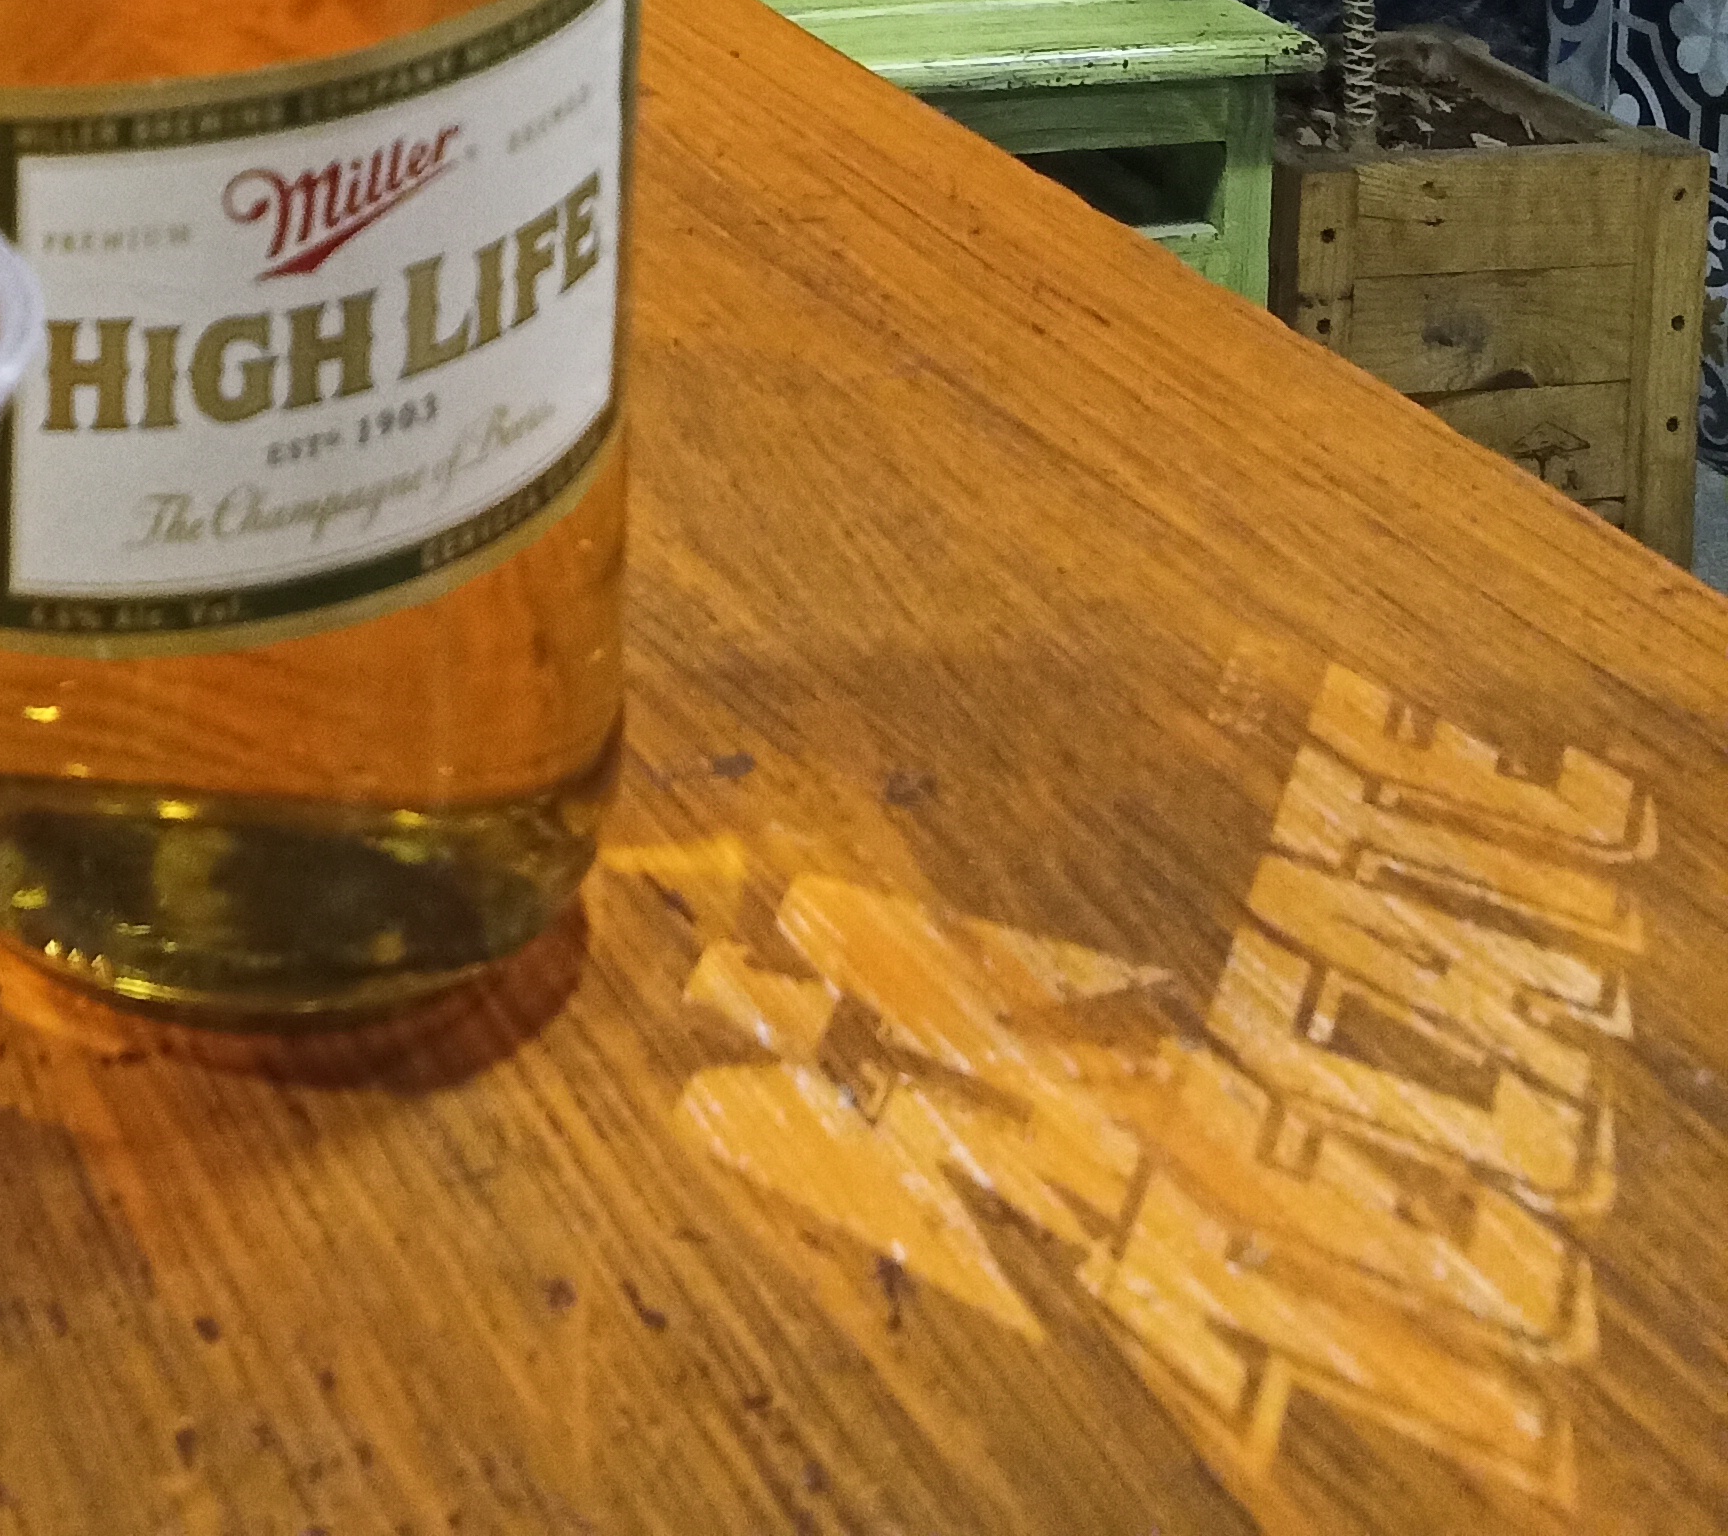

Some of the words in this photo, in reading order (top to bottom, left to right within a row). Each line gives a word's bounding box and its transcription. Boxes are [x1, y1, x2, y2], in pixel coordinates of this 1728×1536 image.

[38, 286, 379, 433] HIGH
[399, 170, 604, 380] LIFE
[221, 124, 462, 278] Miller
[126, 490, 204, 552] The
[1078, 662, 1658, 1508] TECATE
